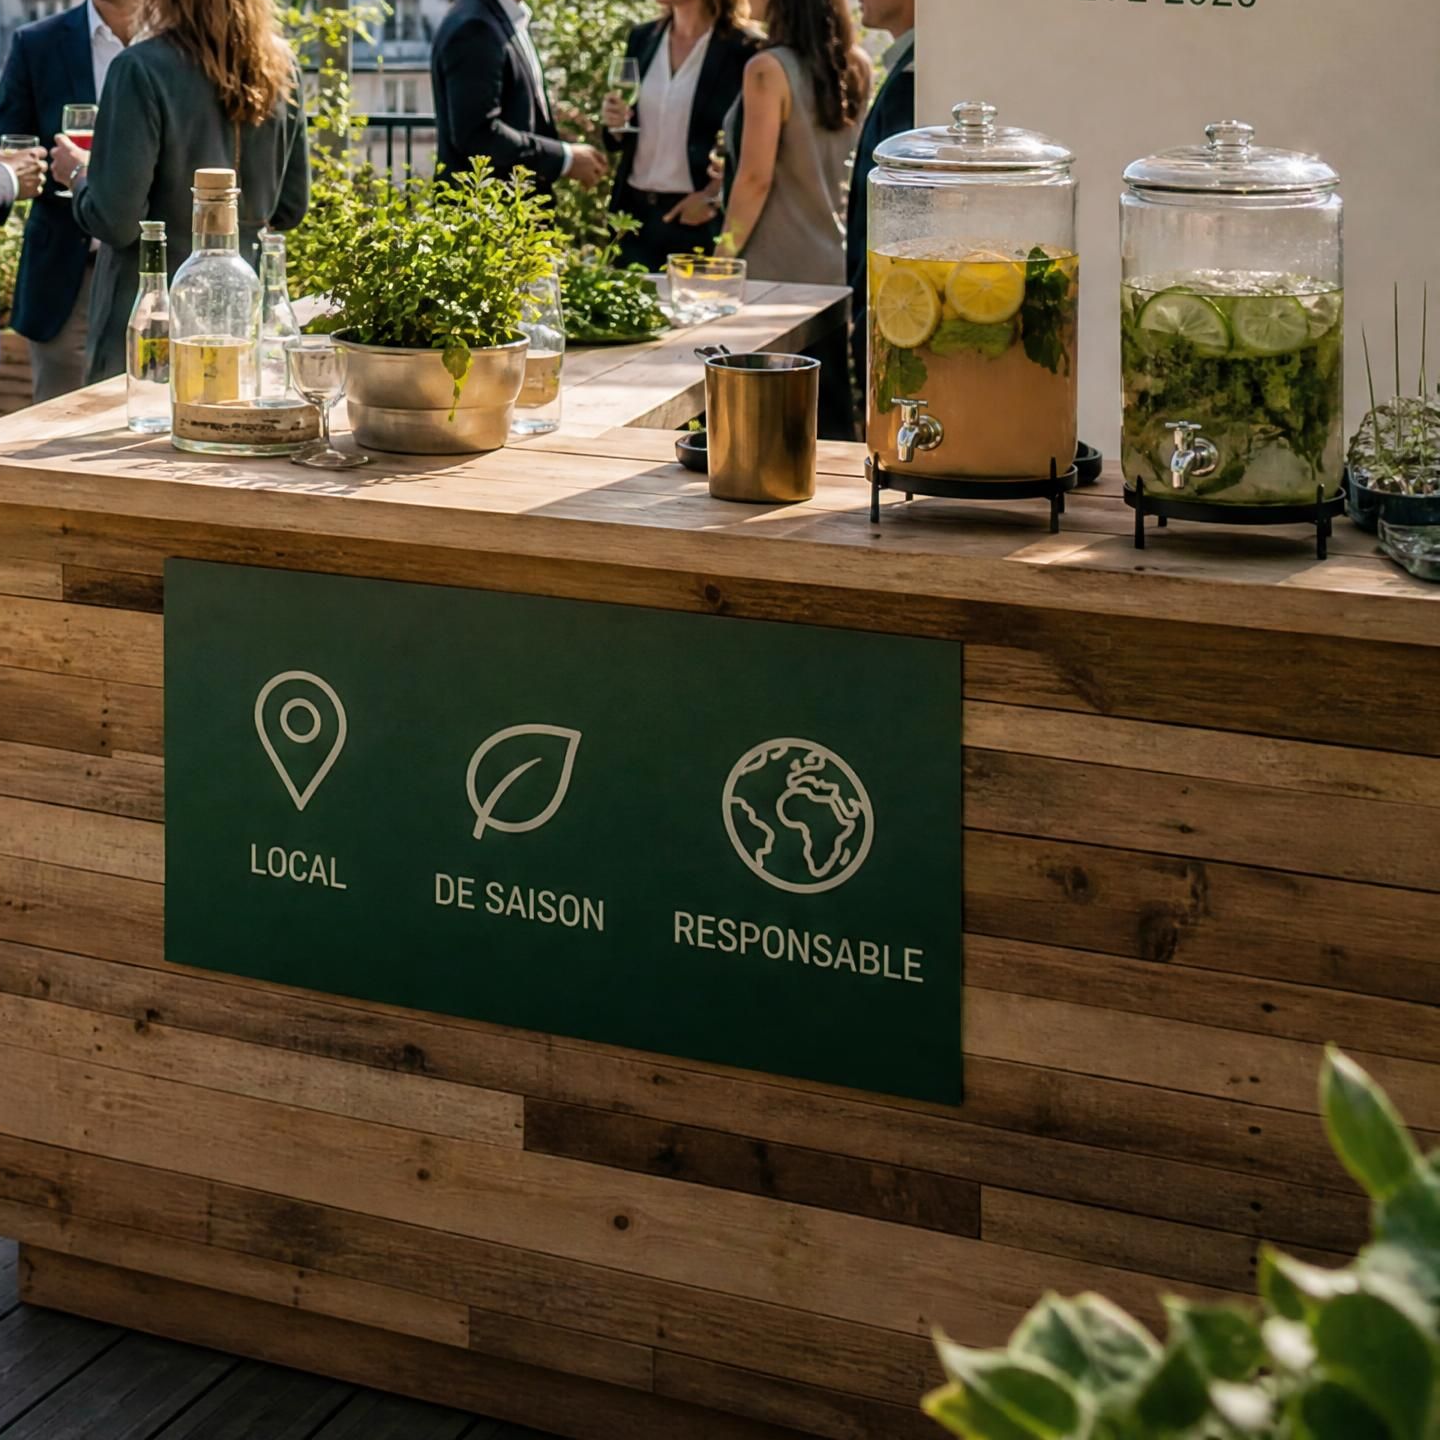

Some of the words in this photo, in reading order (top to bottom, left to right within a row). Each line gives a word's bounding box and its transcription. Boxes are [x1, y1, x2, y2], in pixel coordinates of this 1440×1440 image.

[251, 843, 347, 890] LOCAL
[435, 872, 475, 910] DE
[485, 881, 604, 931] SAISON
[674, 910, 924, 983] RESPONSABLE
